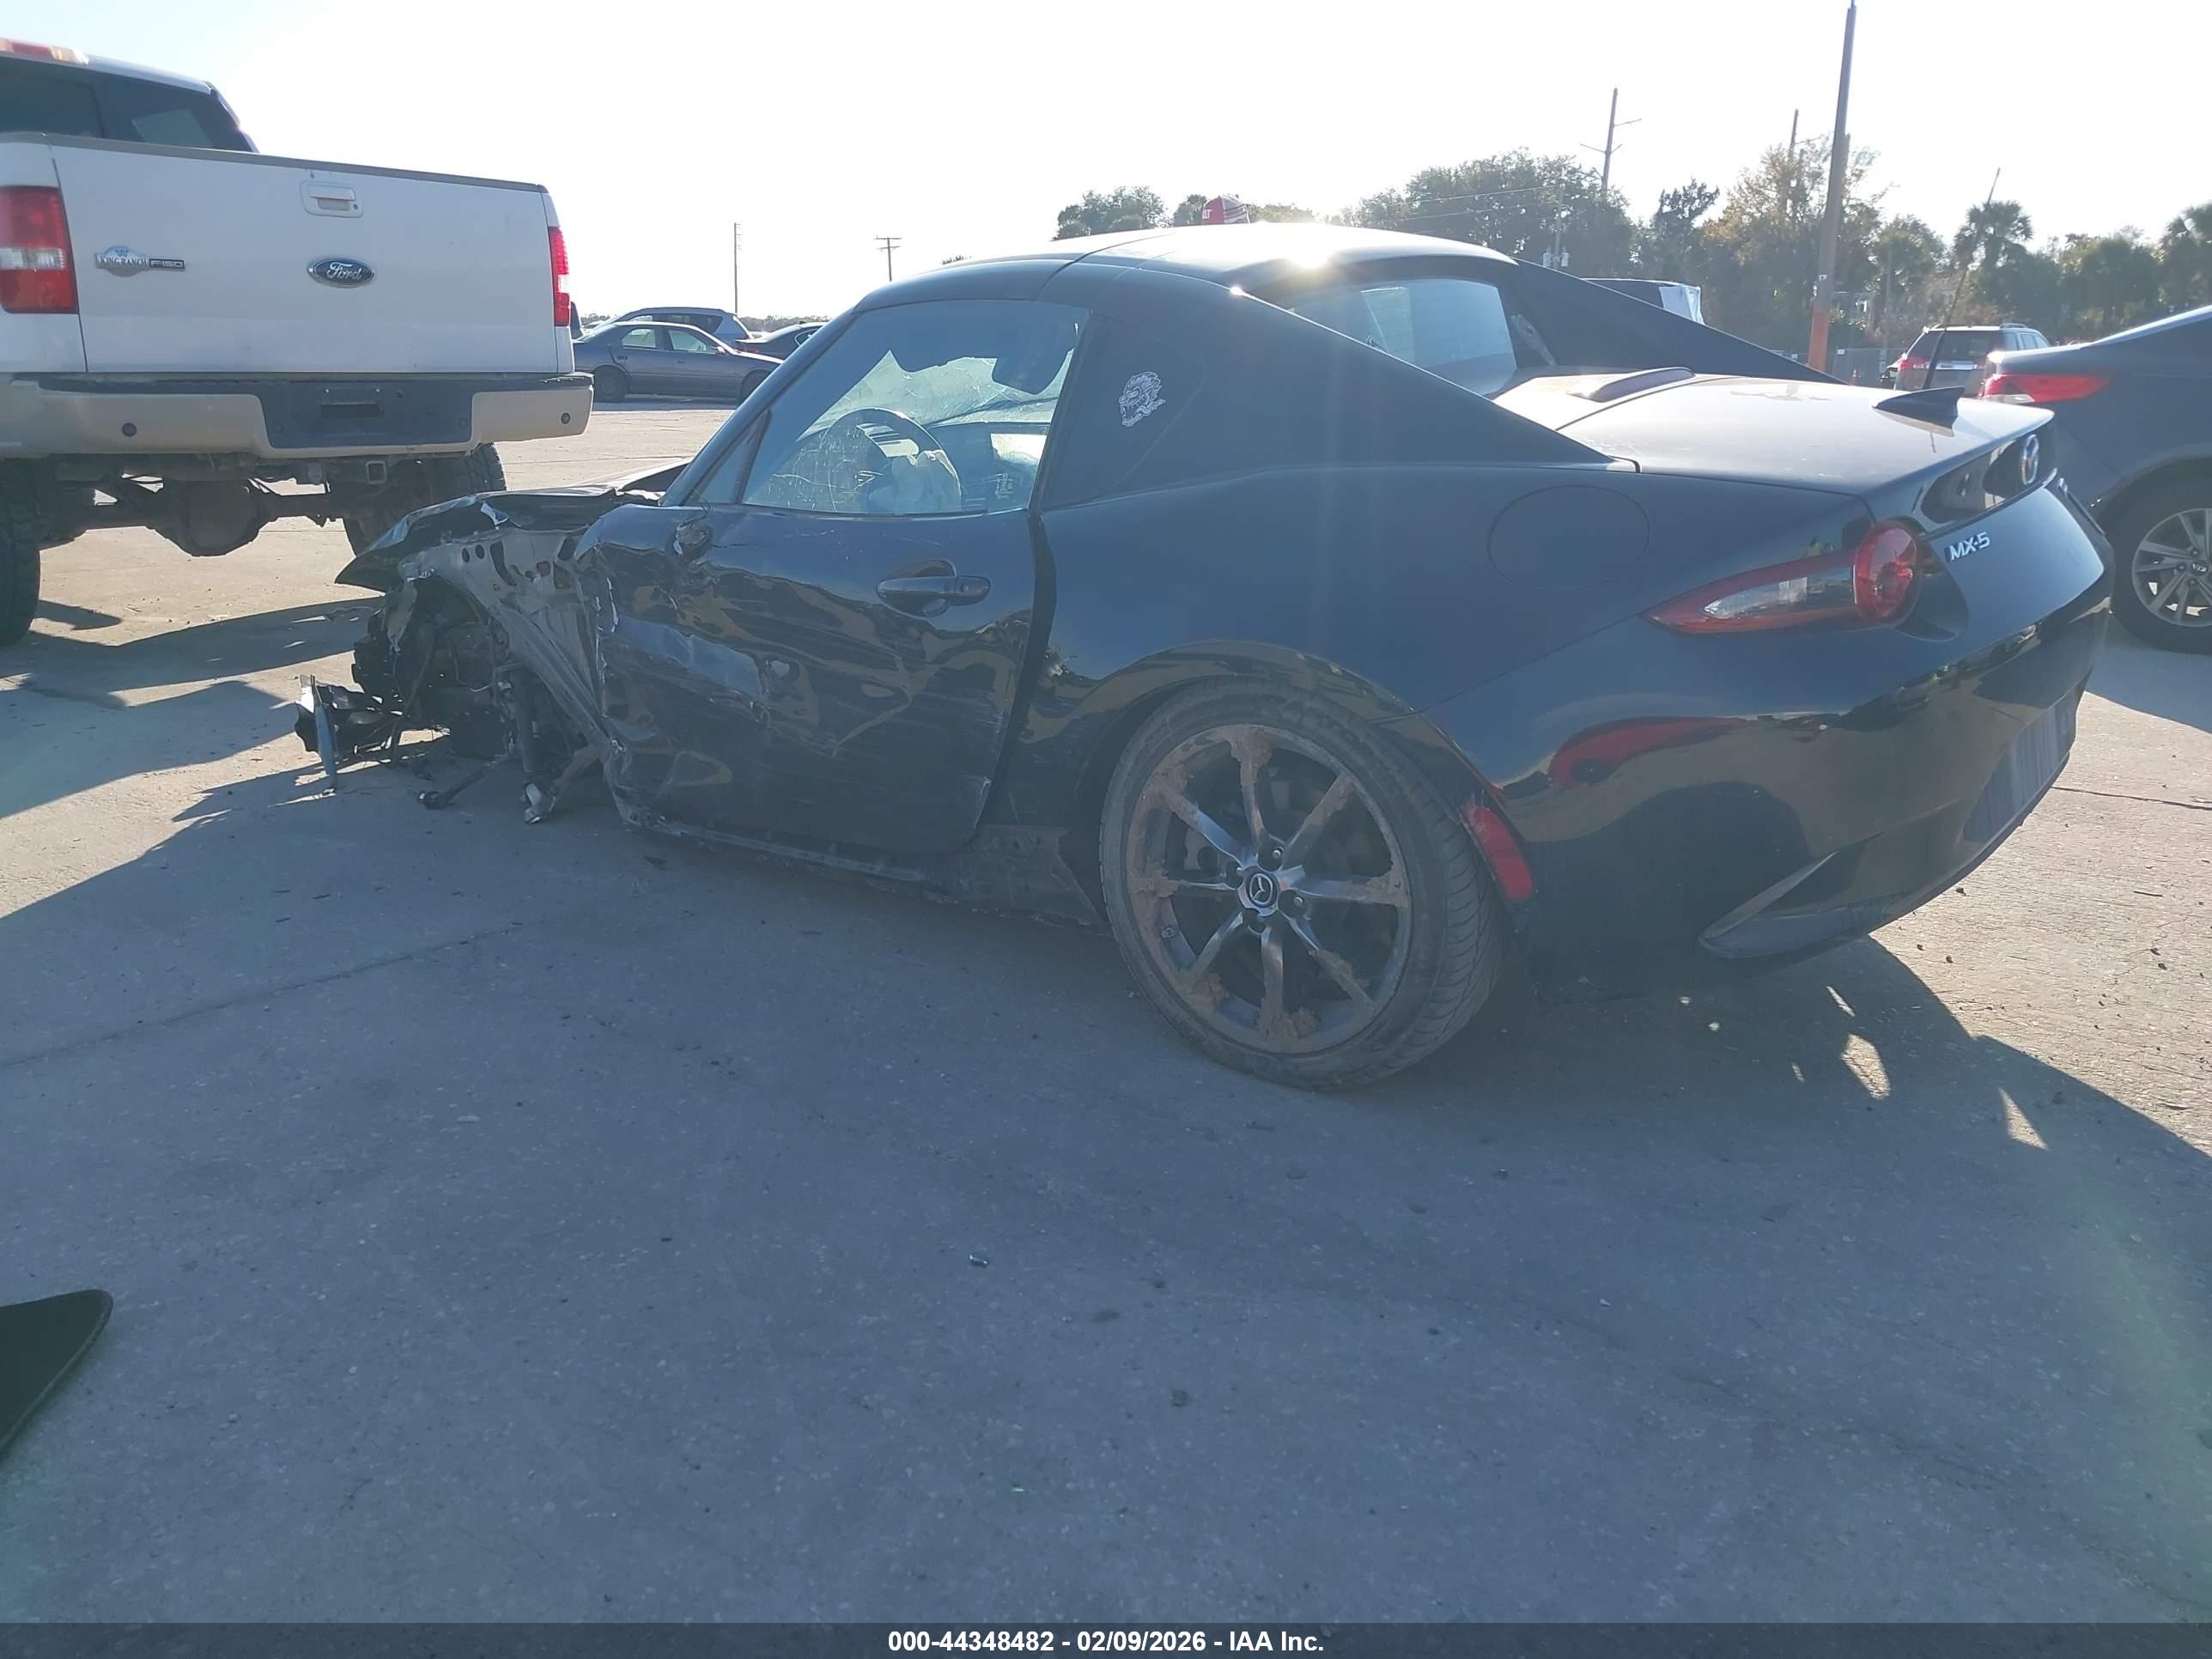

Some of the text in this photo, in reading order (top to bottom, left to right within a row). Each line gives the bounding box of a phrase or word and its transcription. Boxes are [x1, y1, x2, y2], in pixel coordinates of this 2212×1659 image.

[100, 256, 148, 267] KING RANCH
[326, 262, 362, 280] Ford
[1949, 532, 1990, 561] MX-5
